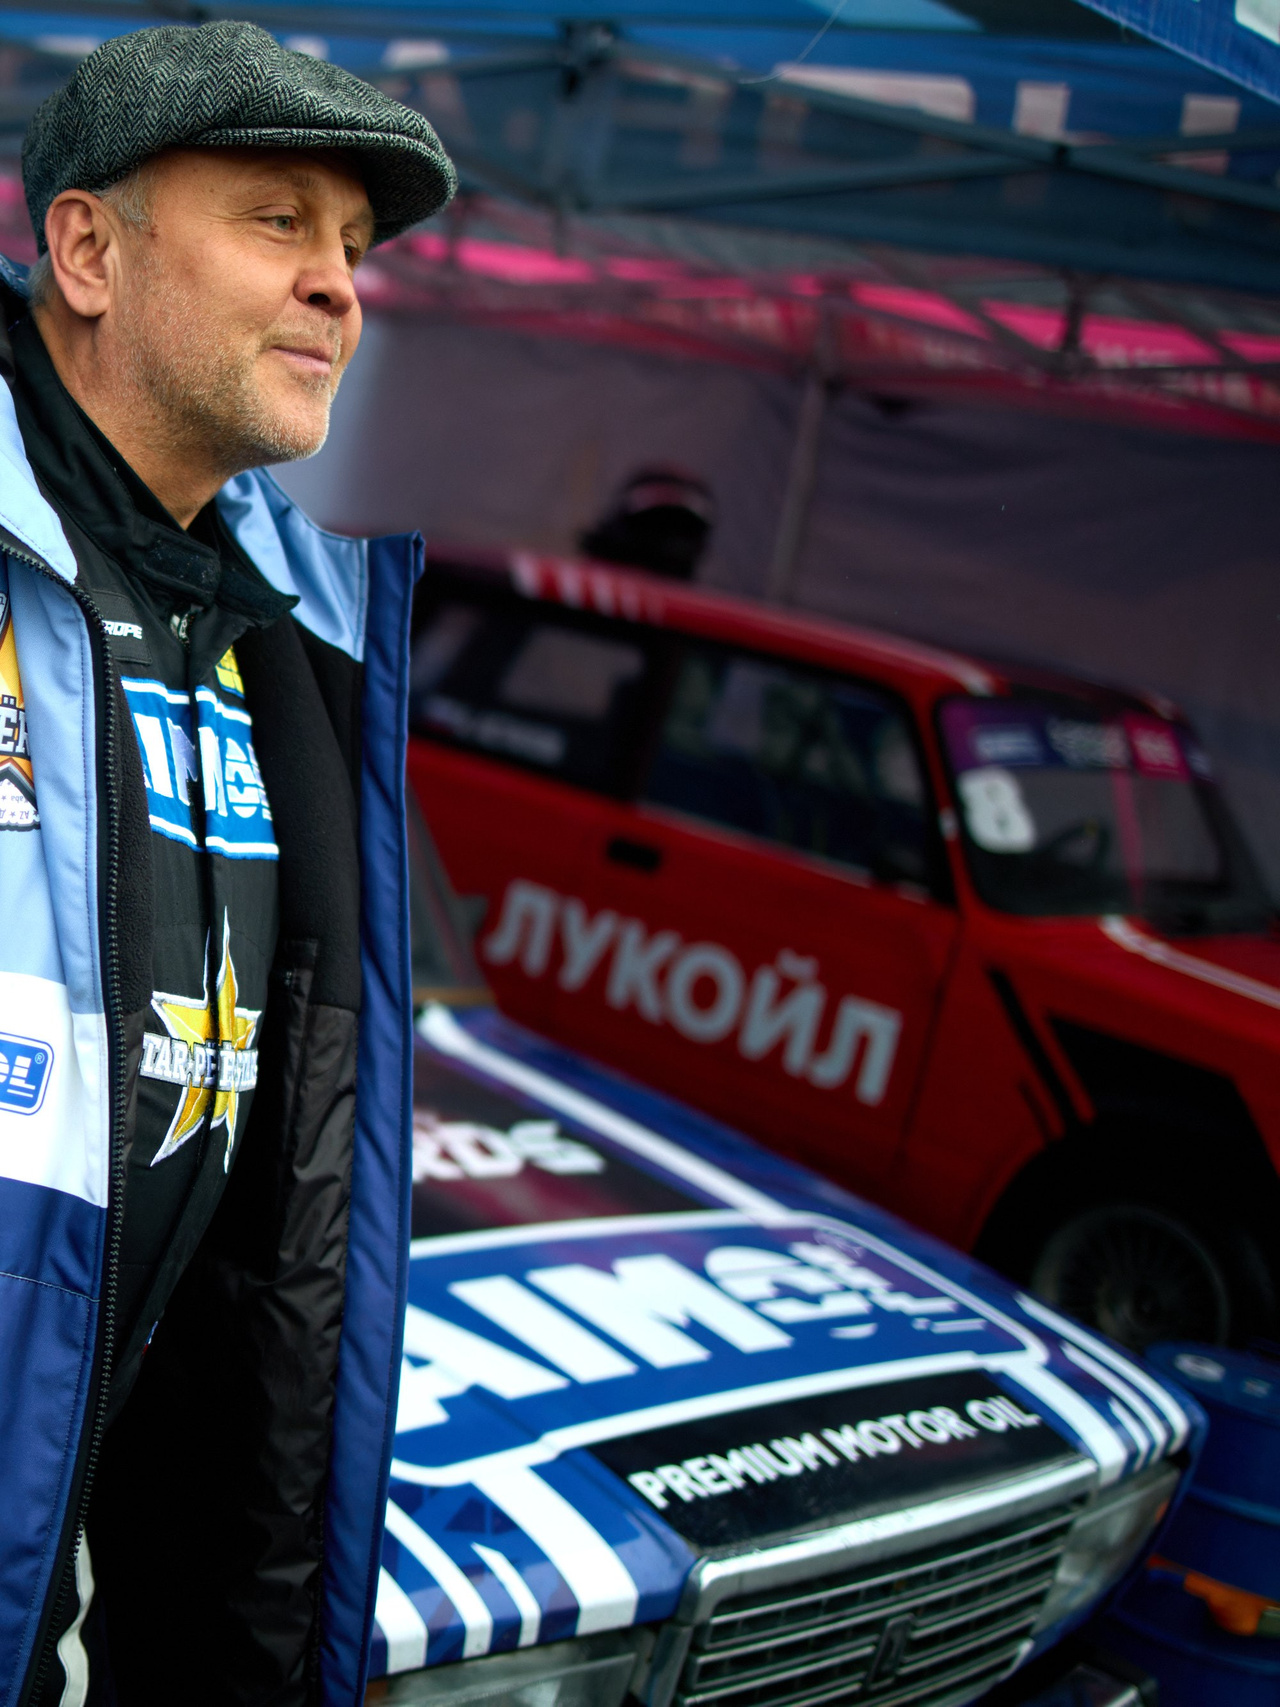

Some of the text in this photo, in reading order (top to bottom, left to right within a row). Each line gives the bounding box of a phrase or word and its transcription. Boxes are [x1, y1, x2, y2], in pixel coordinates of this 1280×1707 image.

[958, 765, 1037, 856] 8
[485, 880, 901, 1107] ЛУКОЙЛ
[141, 1035, 188, 1086] TAR
[627, 1395, 1041, 1511] PREMIUM MOTOR OIL
